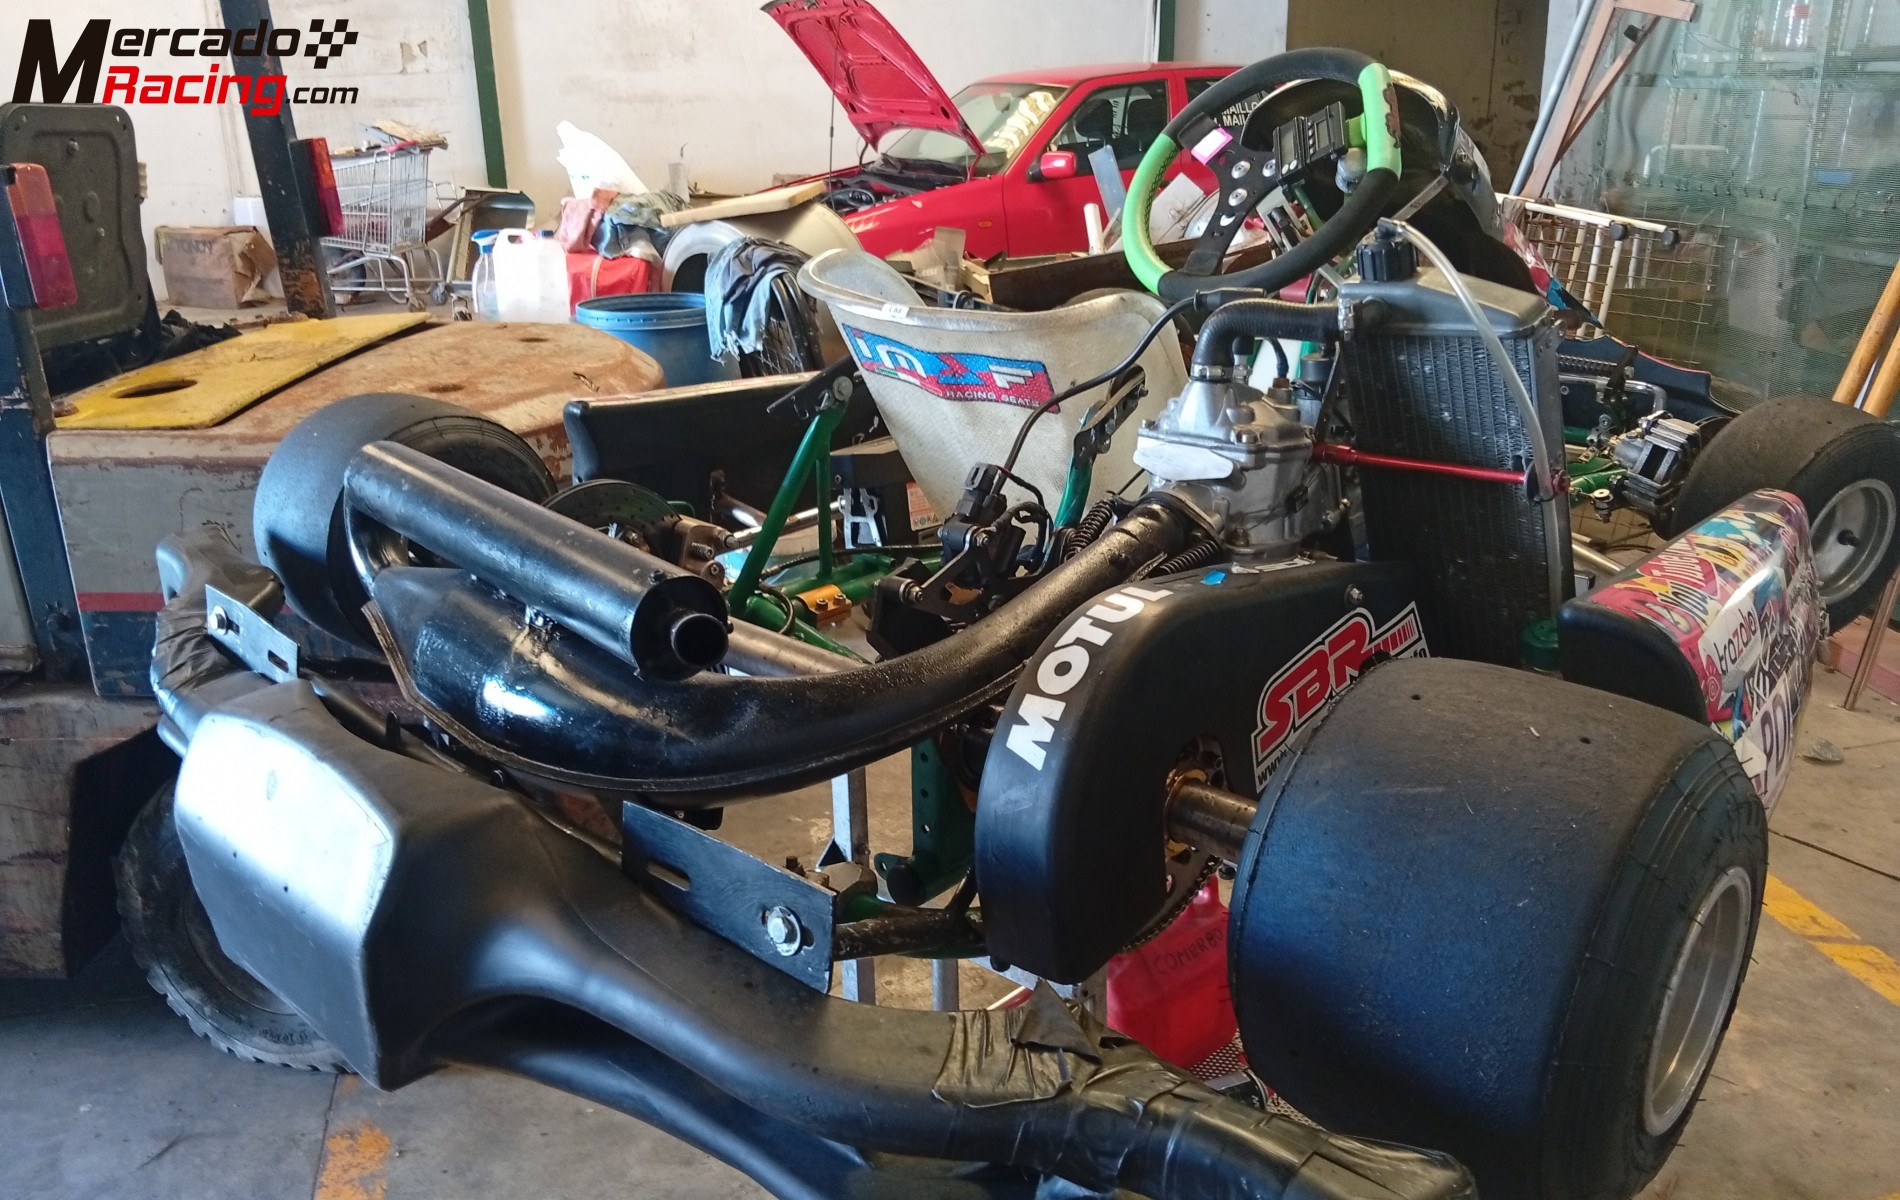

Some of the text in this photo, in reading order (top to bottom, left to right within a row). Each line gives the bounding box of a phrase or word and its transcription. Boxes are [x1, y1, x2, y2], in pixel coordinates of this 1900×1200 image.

[946, 390, 1040, 407] RACING SEATS
[1006, 586, 1175, 772] MOTUL
[1258, 620, 1372, 755] SBR
